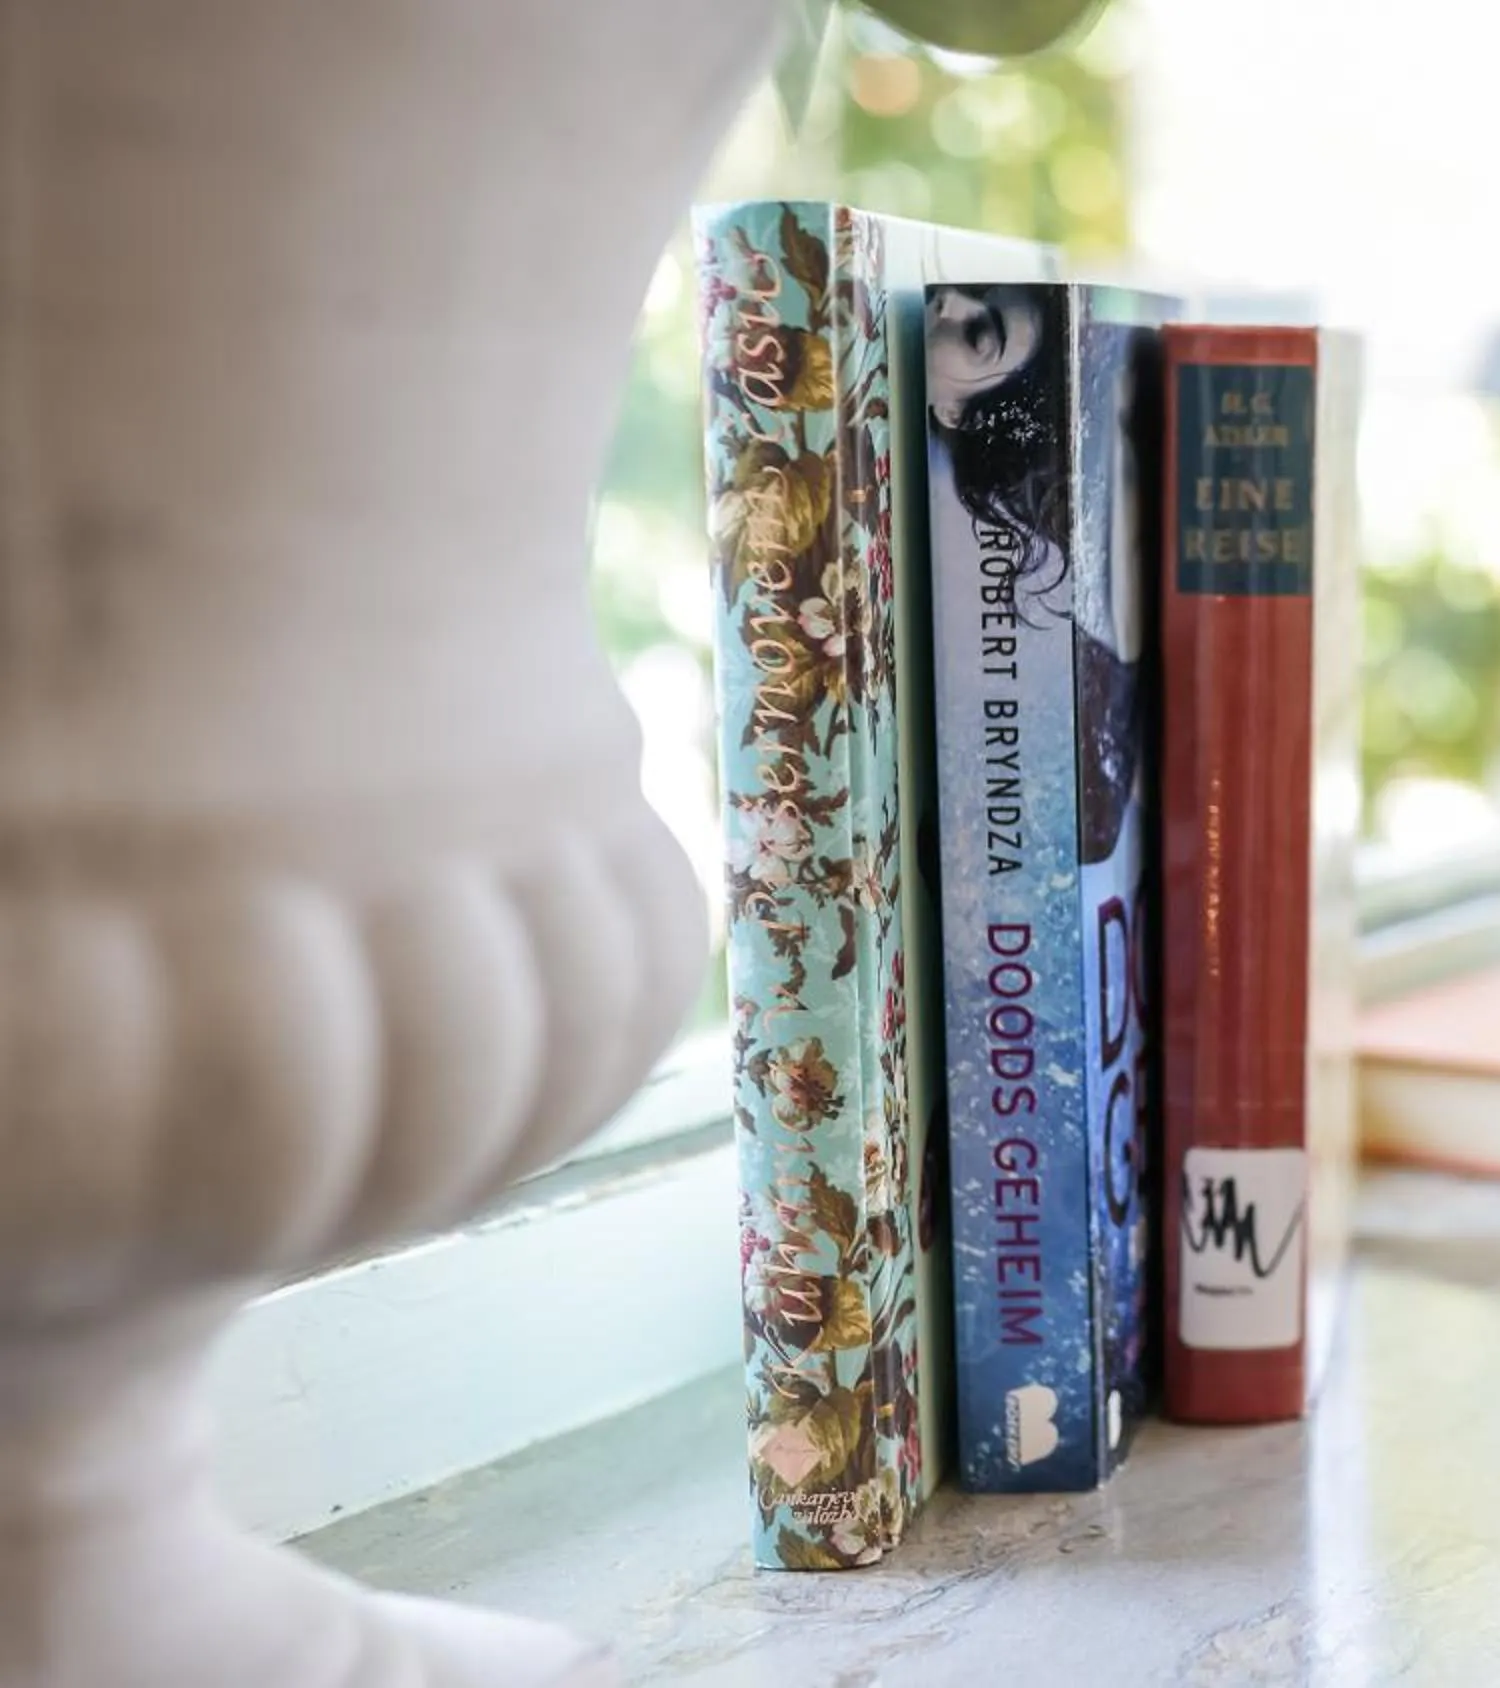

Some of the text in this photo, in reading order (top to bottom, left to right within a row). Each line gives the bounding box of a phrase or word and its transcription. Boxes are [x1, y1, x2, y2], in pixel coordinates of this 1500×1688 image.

[1184, 527, 1302, 564] REISE
[1195, 477, 1295, 512] EINE
[979, 529, 1022, 877] ROBERT BRYNDZA
[988, 922, 1041, 1348] DOODS GEHEIM
